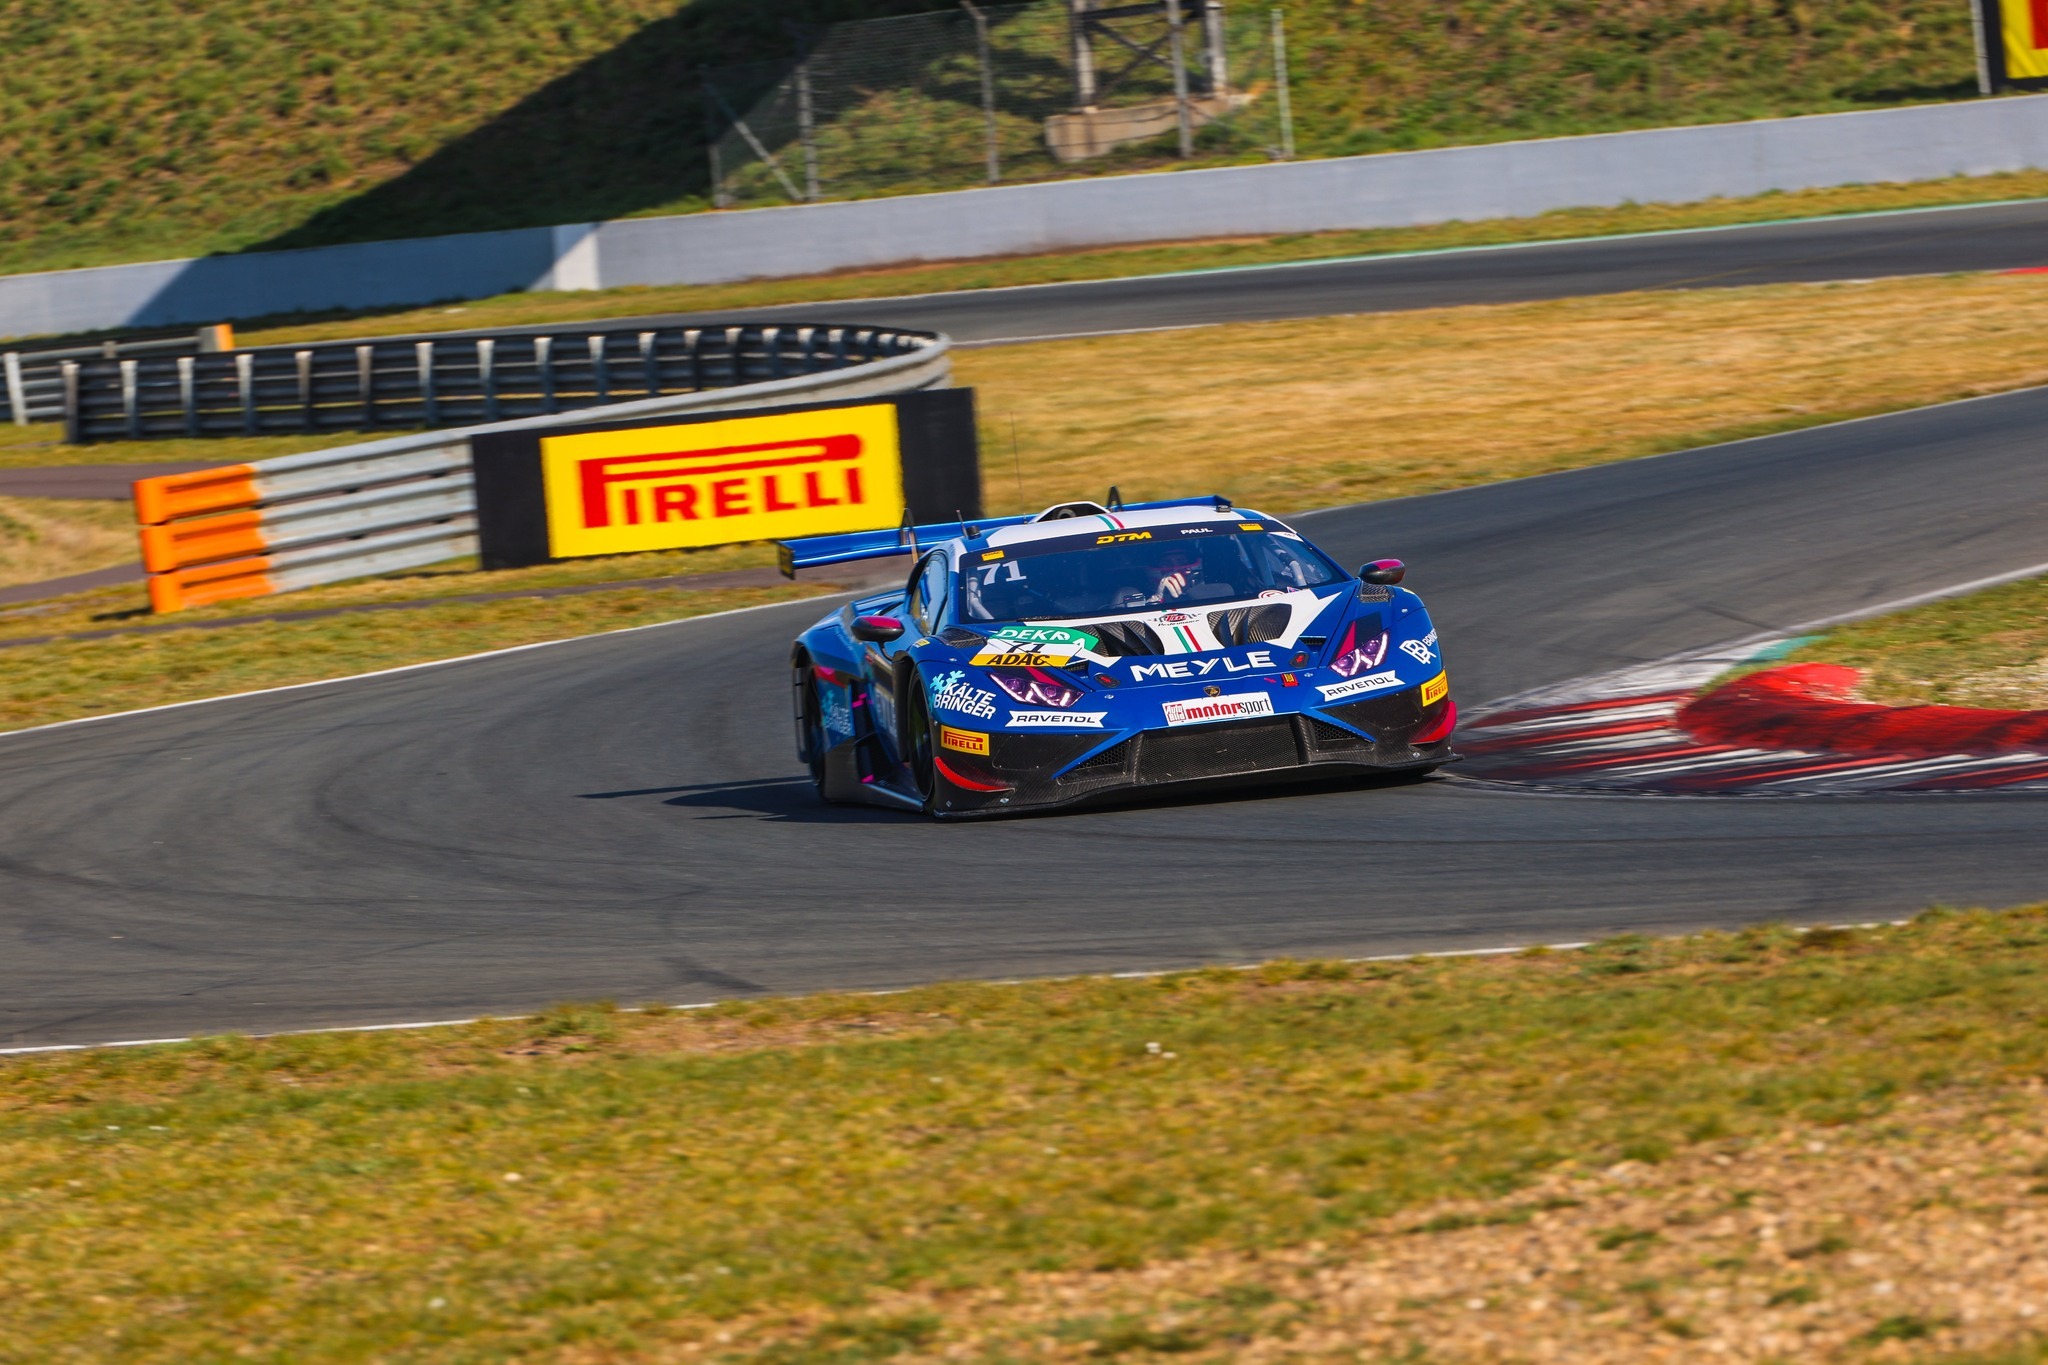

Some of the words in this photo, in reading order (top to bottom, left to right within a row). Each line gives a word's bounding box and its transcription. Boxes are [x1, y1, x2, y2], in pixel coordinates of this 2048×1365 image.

[578, 434, 864, 528] PIRELLI
[1096, 532, 1152, 545] DTM
[1180, 527, 1213, 535] PAUL
[977, 560, 1027, 585] 71
[996, 629, 1086, 650] DEKRA
[1006, 640, 1046, 654] 71
[986, 654, 1050, 666] ADAC
[1130, 650, 1277, 682] MEYLE
[944, 682, 997, 706] KÄLTE
[1325, 676, 1394, 696] RAVENOL
[933, 694, 997, 720] BRINGER
[1016, 715, 1095, 724] RAVENOL
[943, 730, 984, 751] PIRELLI
